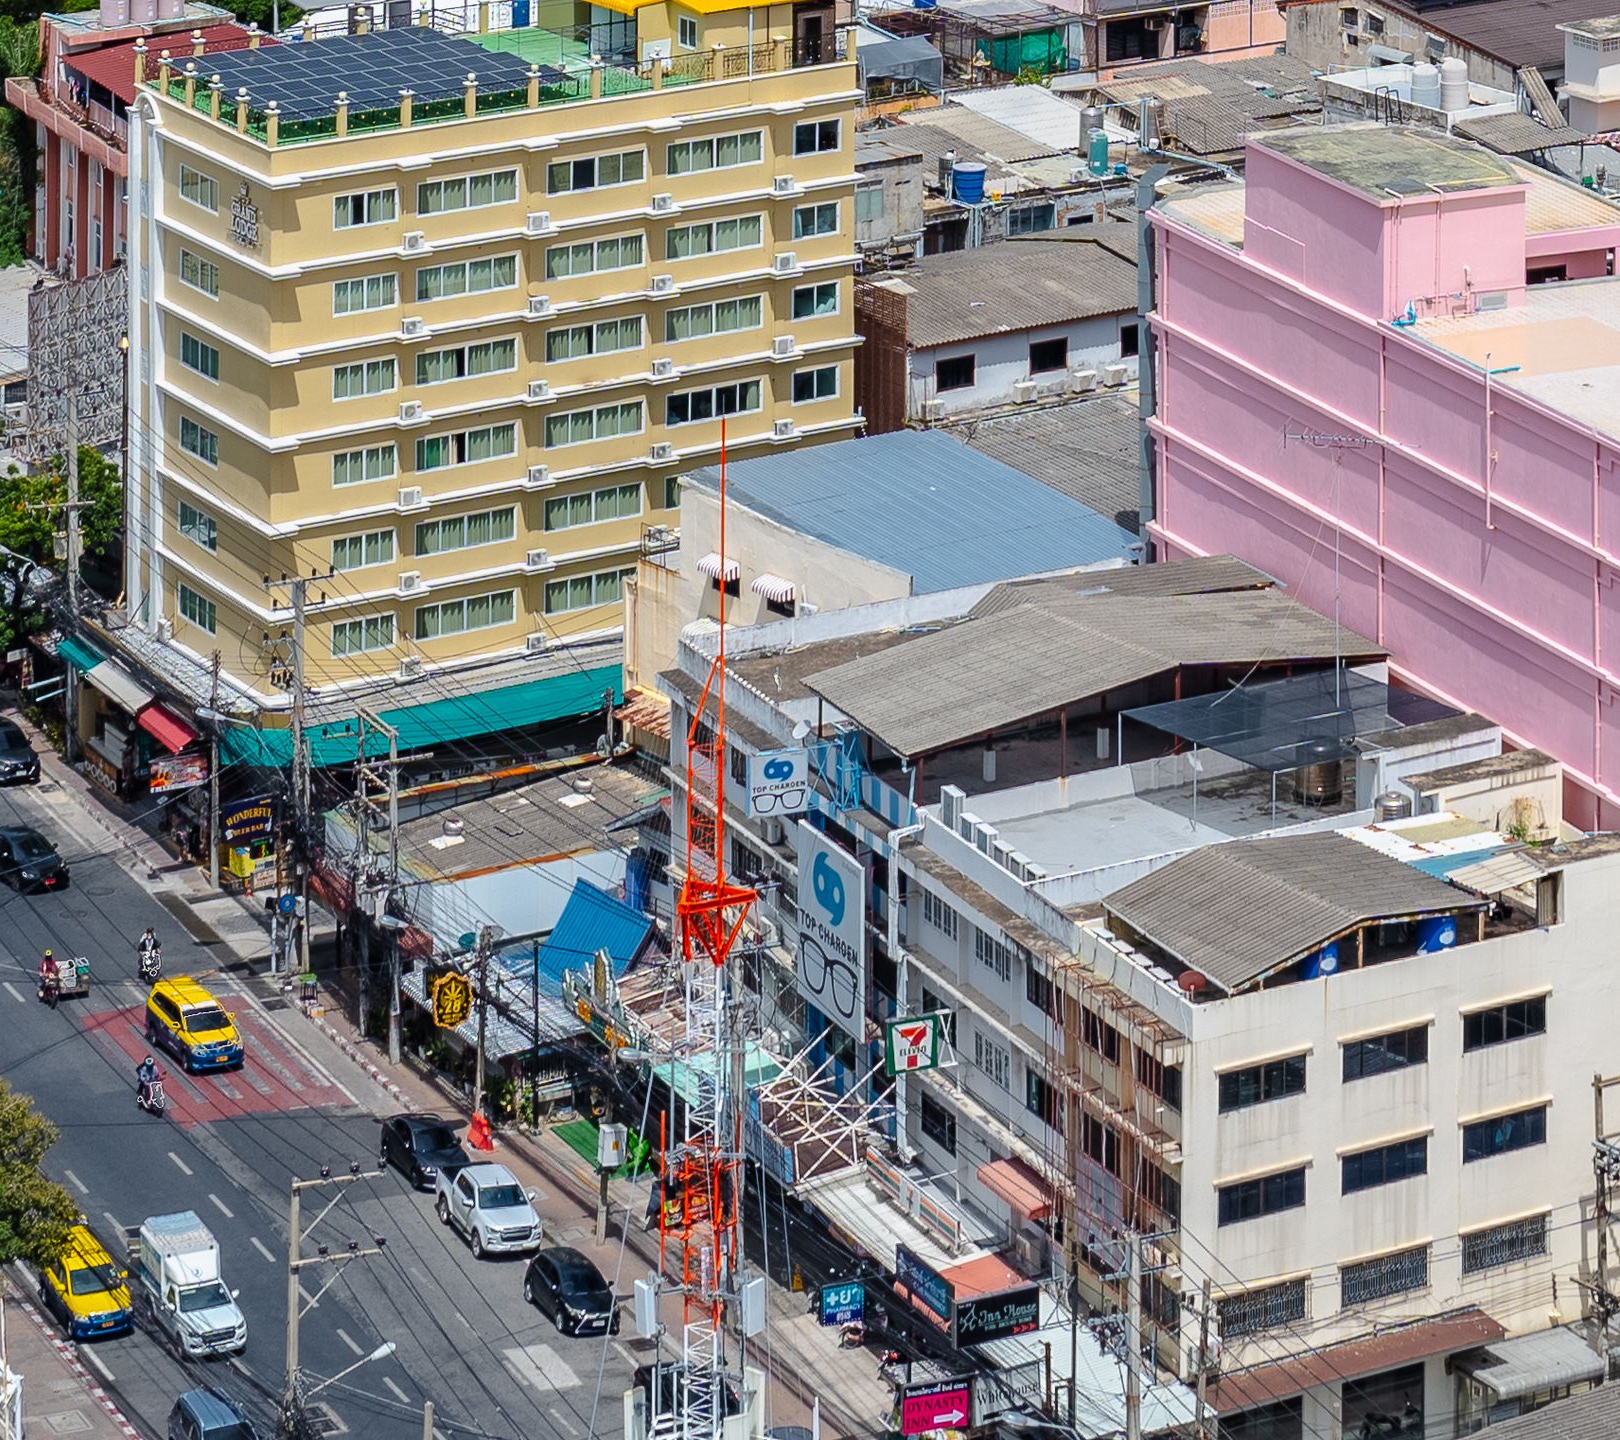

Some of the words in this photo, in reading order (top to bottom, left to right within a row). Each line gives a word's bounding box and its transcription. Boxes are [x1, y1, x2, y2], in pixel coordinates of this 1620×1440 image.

[752, 785, 768, 794] TOP
[769, 780, 806, 792] CHAROEN
[226, 807, 272, 827] WONDERFUL
[800, 908, 817, 931] TOP
[818, 926, 859, 967] CHAROEN
[826, 1305, 861, 1314] PHARMACY
[979, 1309, 1001, 1326] Inn
[1004, 1303, 1037, 1317] House
[906, 1395, 965, 1413] DYNASTY
[906, 1417, 930, 1430] INN
